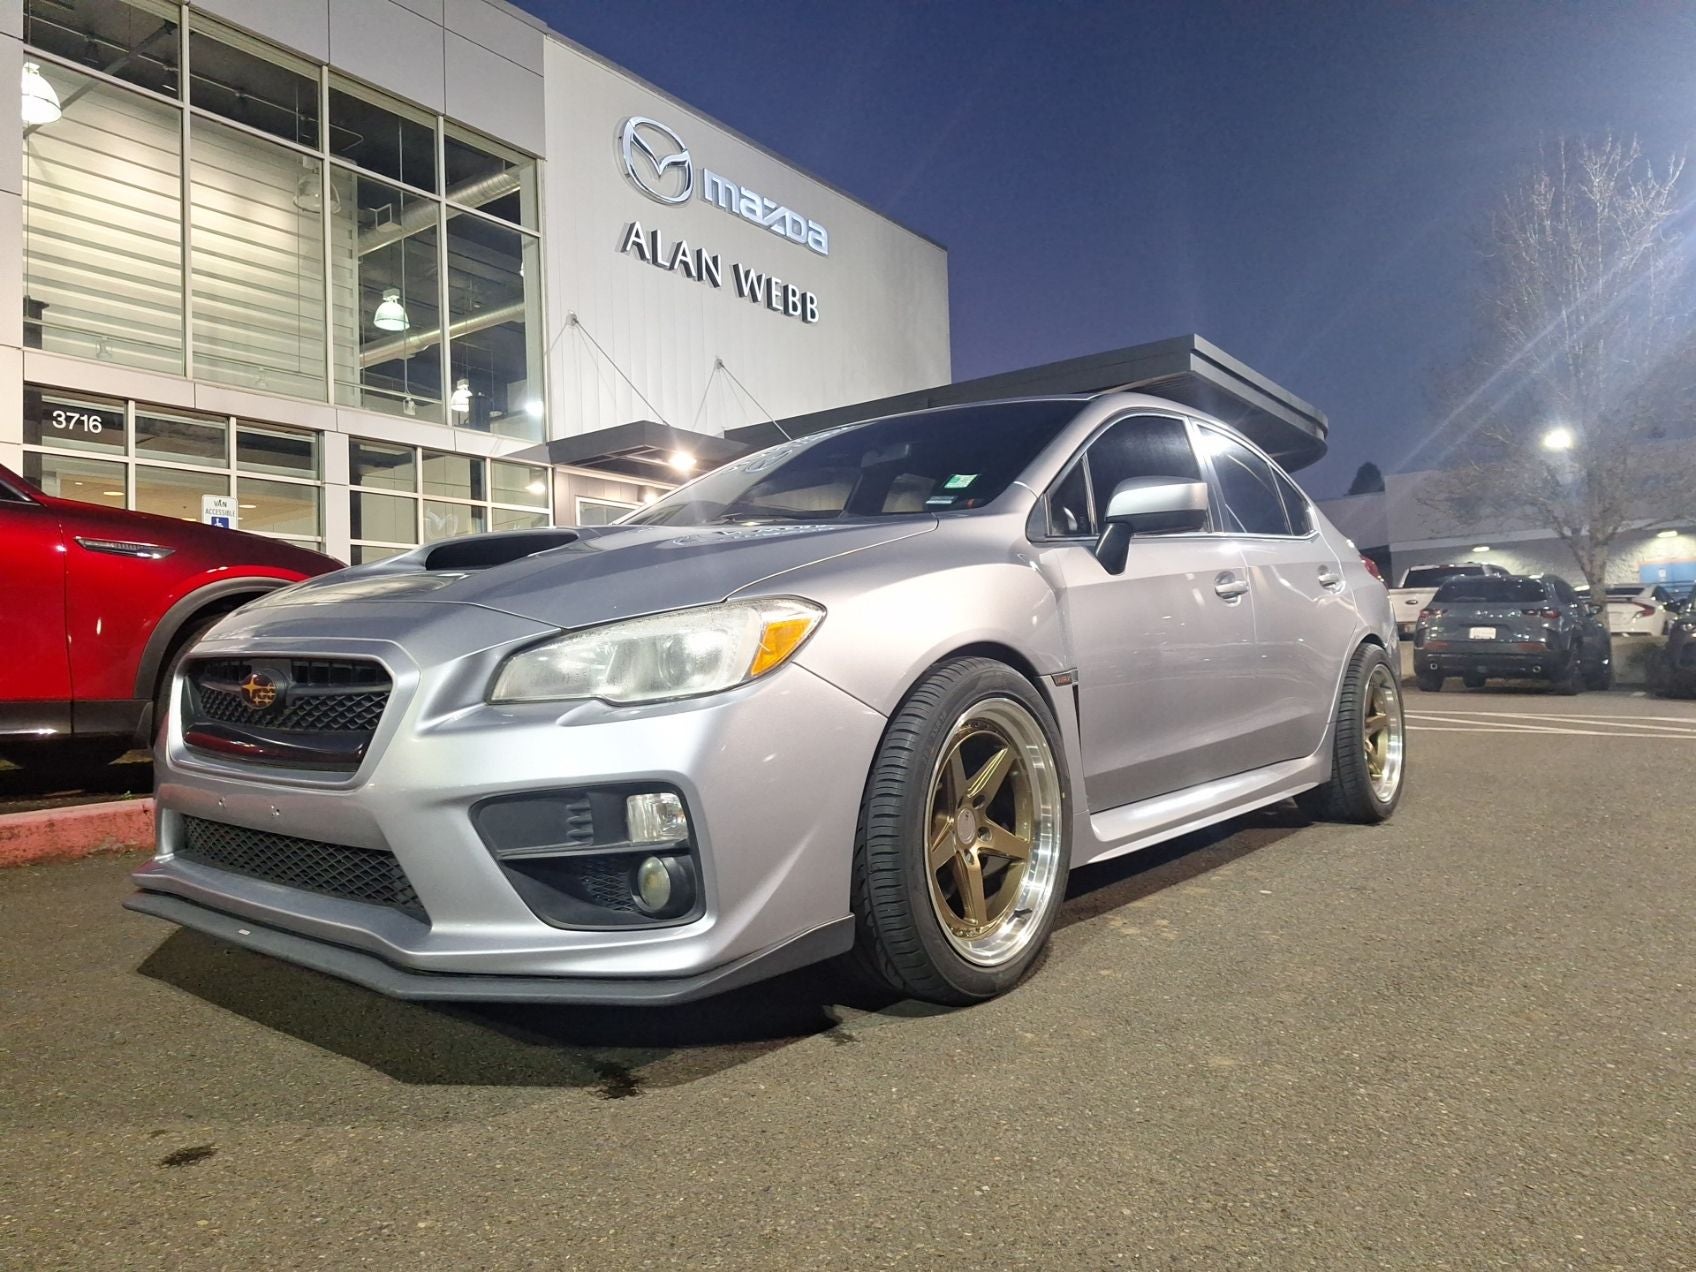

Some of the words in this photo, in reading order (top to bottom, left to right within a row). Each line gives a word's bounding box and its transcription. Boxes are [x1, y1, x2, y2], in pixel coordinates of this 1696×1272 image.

[620, 220, 722, 288] ALAN
[732, 263, 820, 324] WEBB
[52, 410, 103, 434] 3716
[213, 499, 228, 508] VAN
[205, 508, 236, 517] ACCESSIBLE
